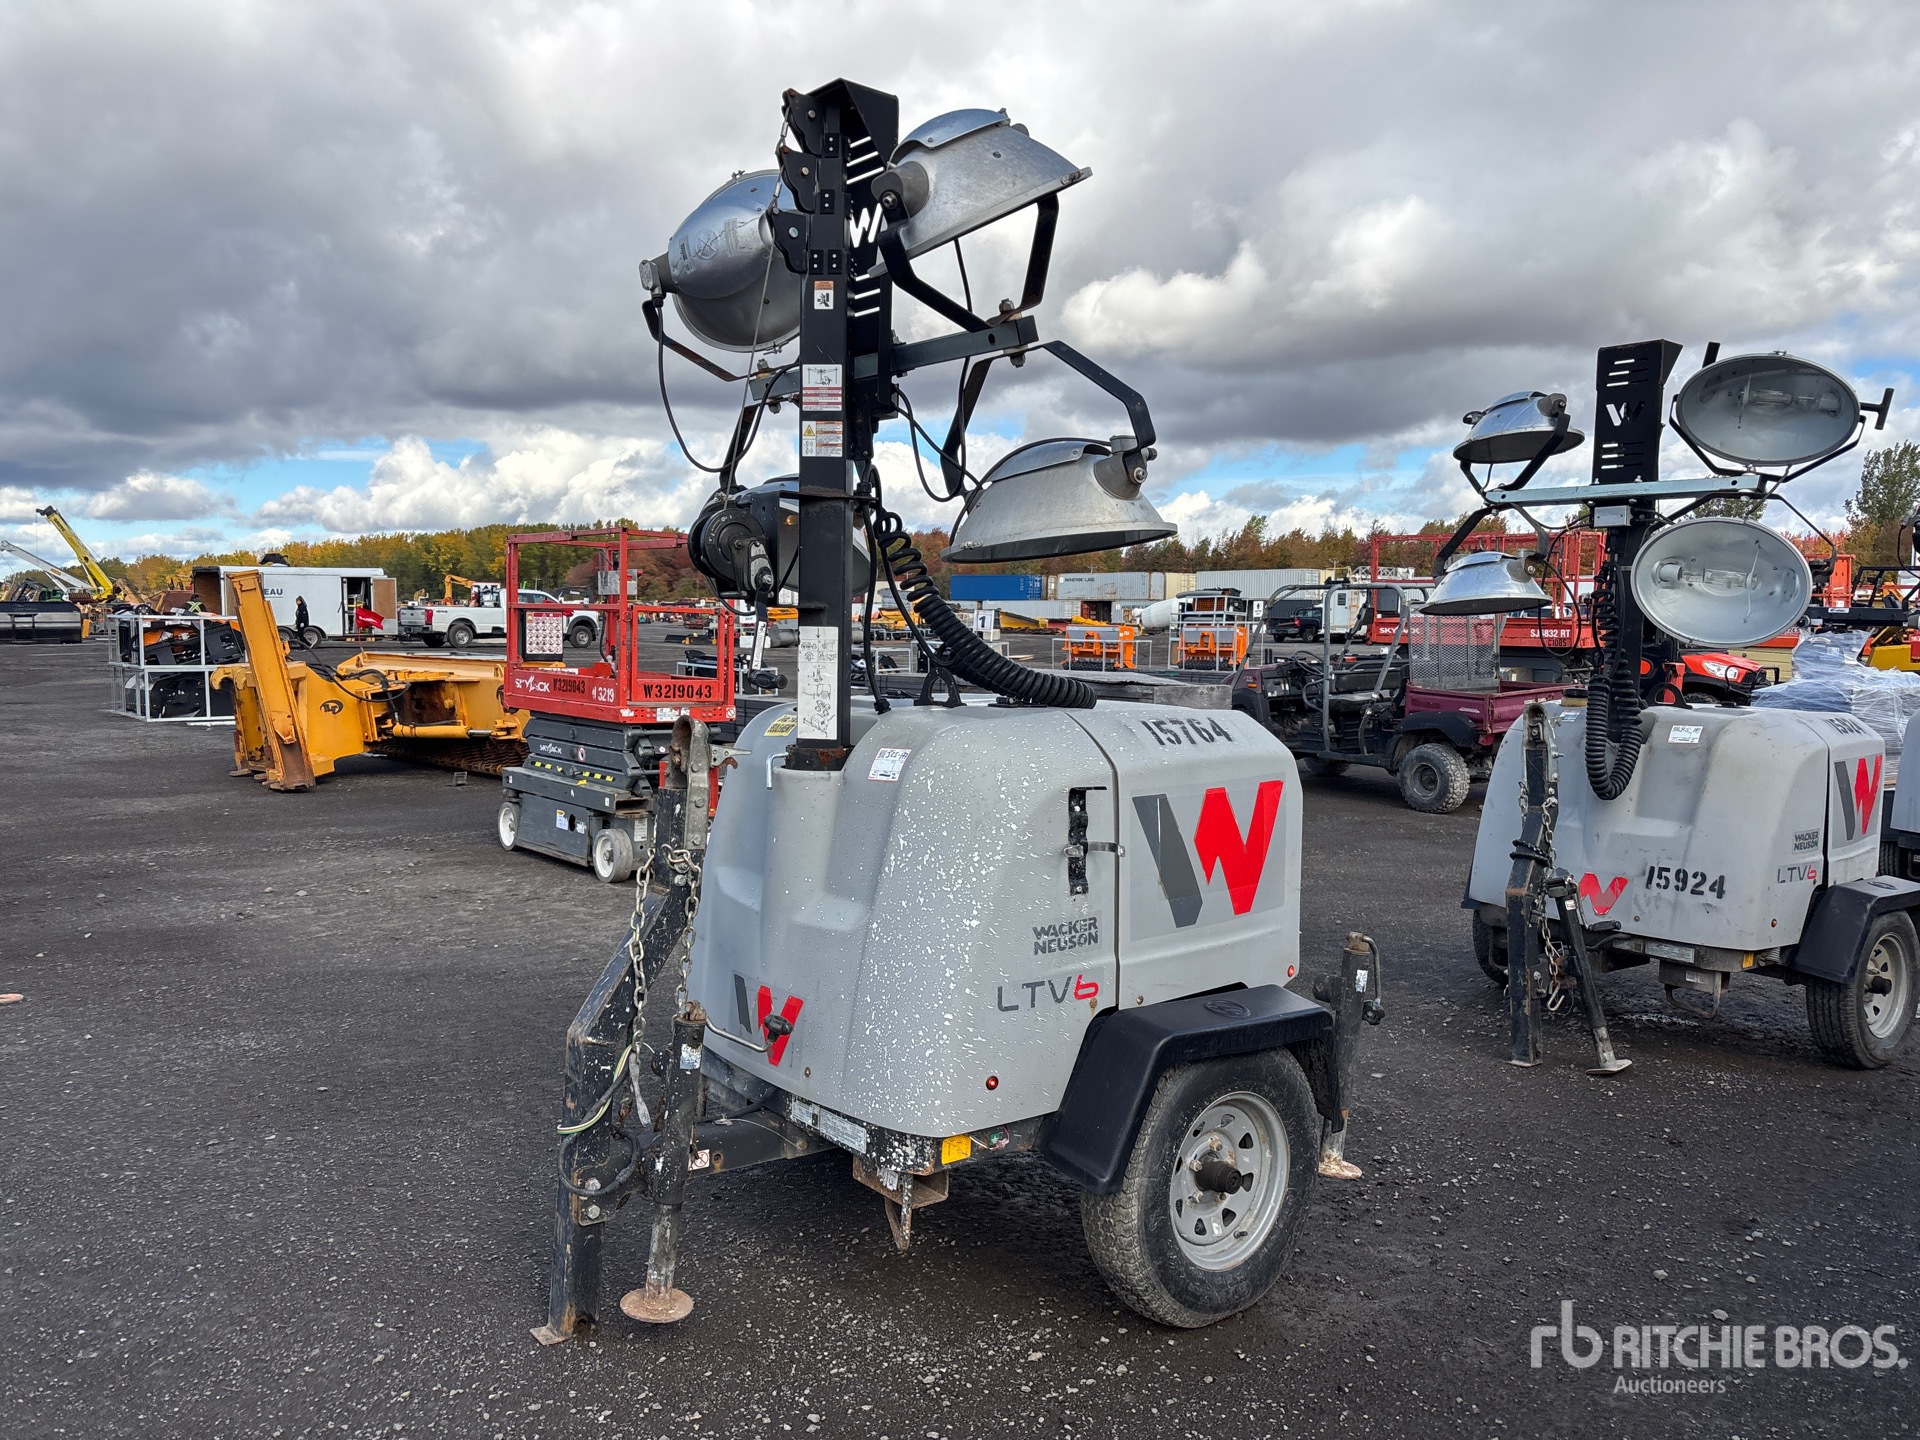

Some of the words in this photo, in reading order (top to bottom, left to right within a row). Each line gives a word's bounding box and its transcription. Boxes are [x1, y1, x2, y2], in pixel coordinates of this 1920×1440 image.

[979, 616, 986, 628] 1
[1560, 629, 1571, 638] RT
[552, 678, 586, 694] W3219043
[643, 684, 712, 699] W3219043
[598, 686, 615, 703] 3219
[1140, 717, 1233, 746] 15764
[540, 742, 563, 755] SKYJACK
[1794, 831, 1819, 843] WACKER
[1794, 840, 1819, 851] NEUSON
[1645, 865, 1727, 899] 15924
[1777, 864, 1817, 884] LTV6
[1032, 916, 1099, 940] WACKER
[1033, 930, 1099, 955] NEUSON
[998, 974, 1099, 1012] LTV6
